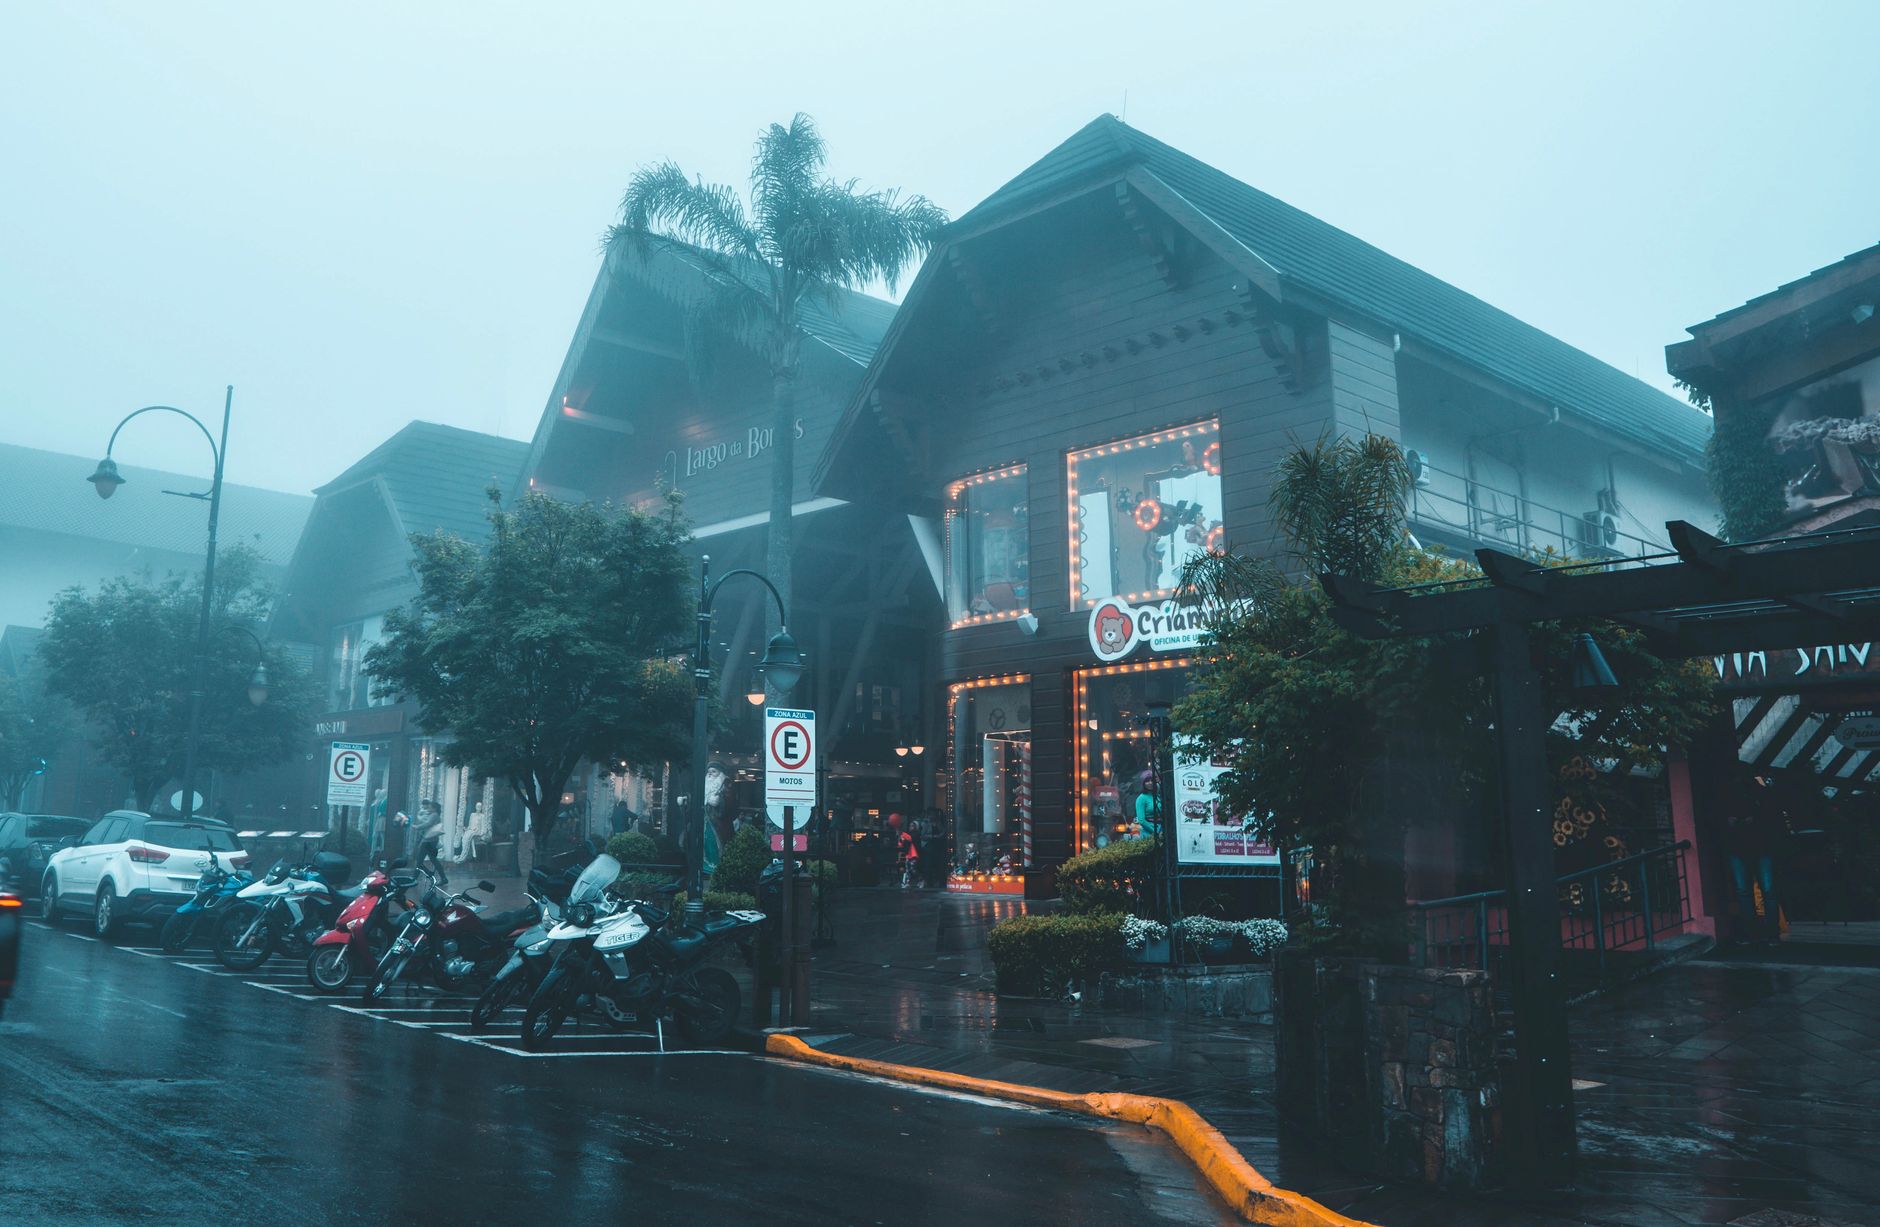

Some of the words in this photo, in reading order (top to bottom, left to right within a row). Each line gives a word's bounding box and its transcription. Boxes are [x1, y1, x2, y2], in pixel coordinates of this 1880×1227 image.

[686, 442, 727, 477] Largo
[730, 440, 742, 457] da
[747, 418, 804, 459] Bors
[1154, 633, 1181, 646] OFICINA
[1182, 633, 1191, 643] DE
[774, 710, 791, 718] ZONA
[792, 711, 808, 719] AZUL
[784, 731, 798, 759] E
[344, 757, 355, 775] E
[779, 777, 803, 785] MOTOS
[607, 932, 640, 945] TIGER
